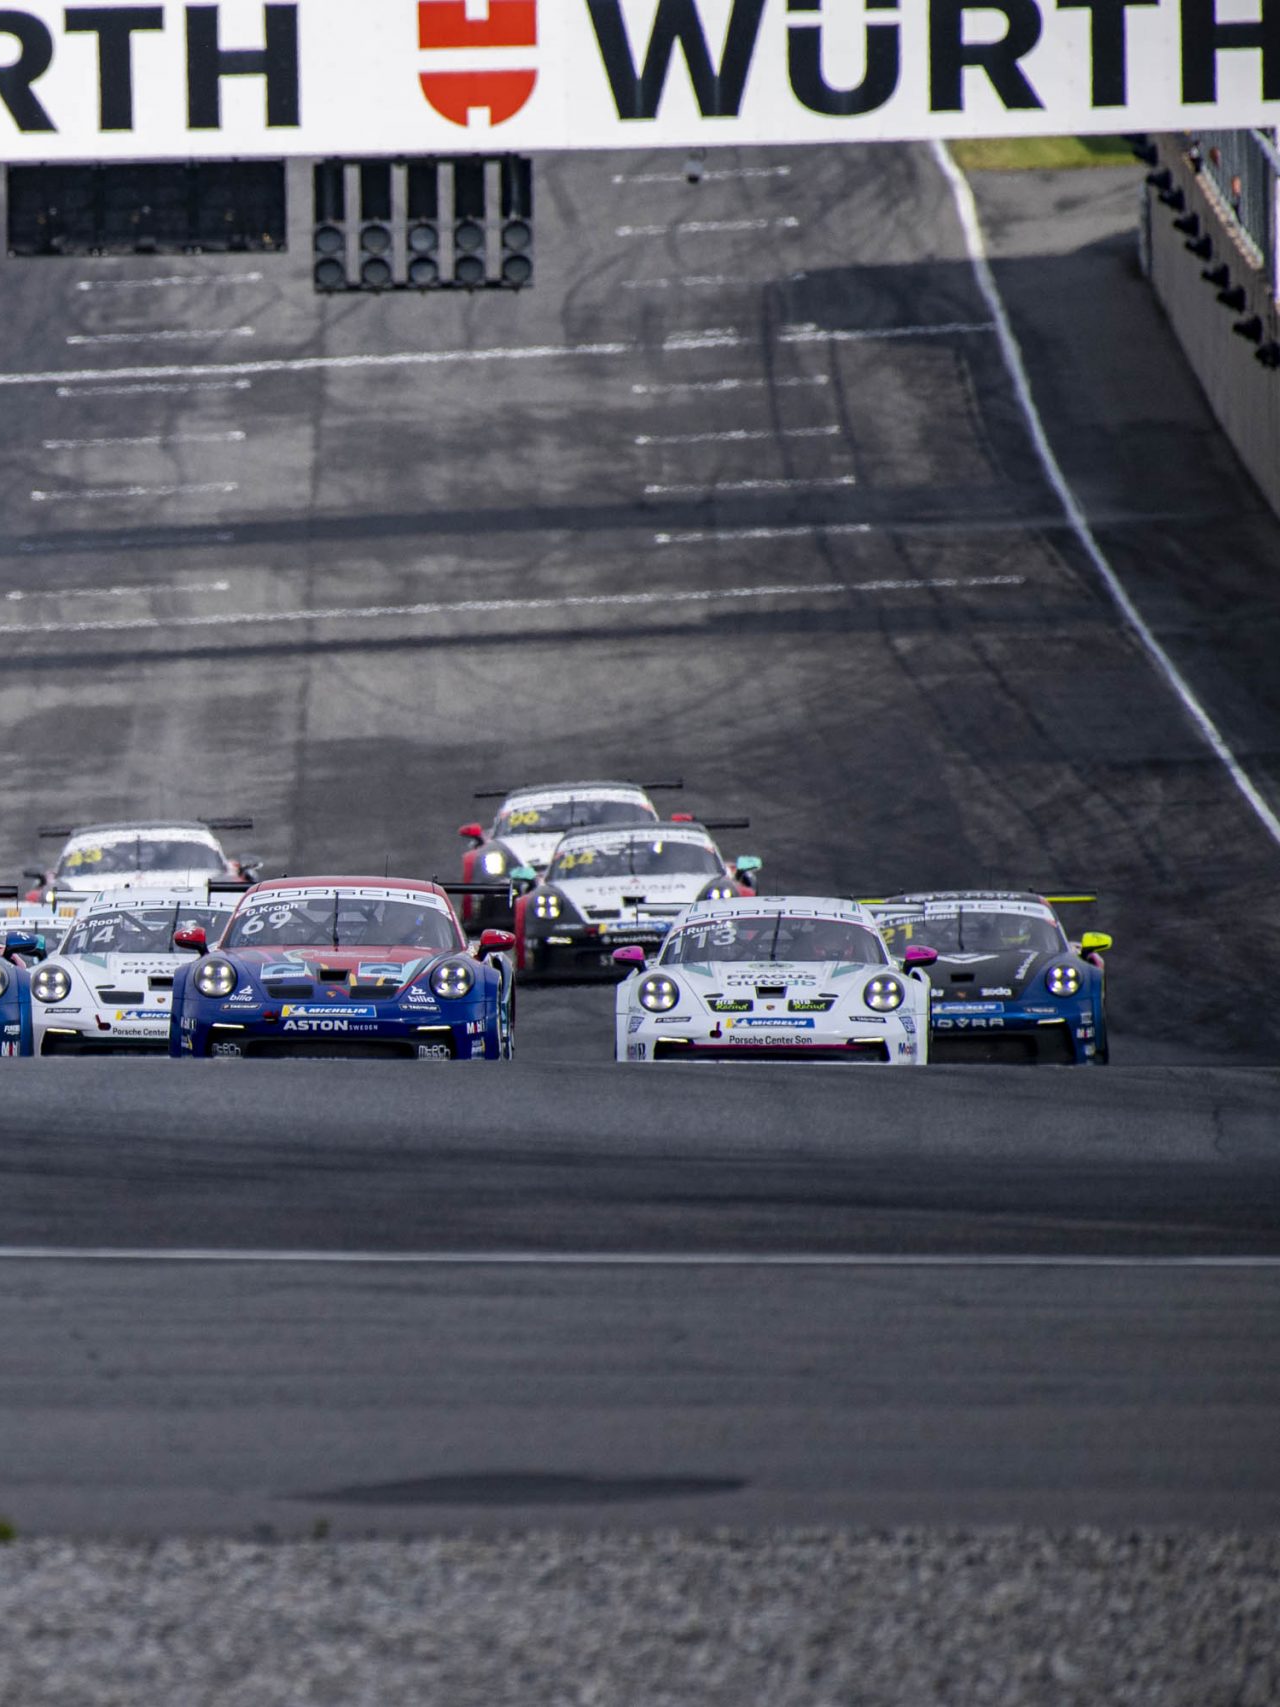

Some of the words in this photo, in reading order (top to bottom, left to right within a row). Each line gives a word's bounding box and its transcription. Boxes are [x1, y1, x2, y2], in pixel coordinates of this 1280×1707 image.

[588, 0, 1280, 120] WÜRTH
[250, 888, 439, 905] PORSCHE
[685, 908, 864, 923] PORSCHE
[75, 917, 121, 933] D.Roos
[241, 911, 292, 935] 69
[71, 924, 116, 950] 14
[668, 928, 738, 955] 113
[881, 924, 913, 945] 21
[726, 979, 817, 987] autodb
[229, 993, 253, 1002] bilia
[408, 994, 435, 1003] bilia
[308, 1007, 369, 1015] MICHELIN
[282, 1019, 349, 1032] ASTON
[749, 1018, 808, 1027] MICHELIN
[112, 1027, 142, 1037] Porsche
[143, 1027, 168, 1037] Center
[728, 1035, 763, 1045] Porsche
[764, 1035, 794, 1045] Center
